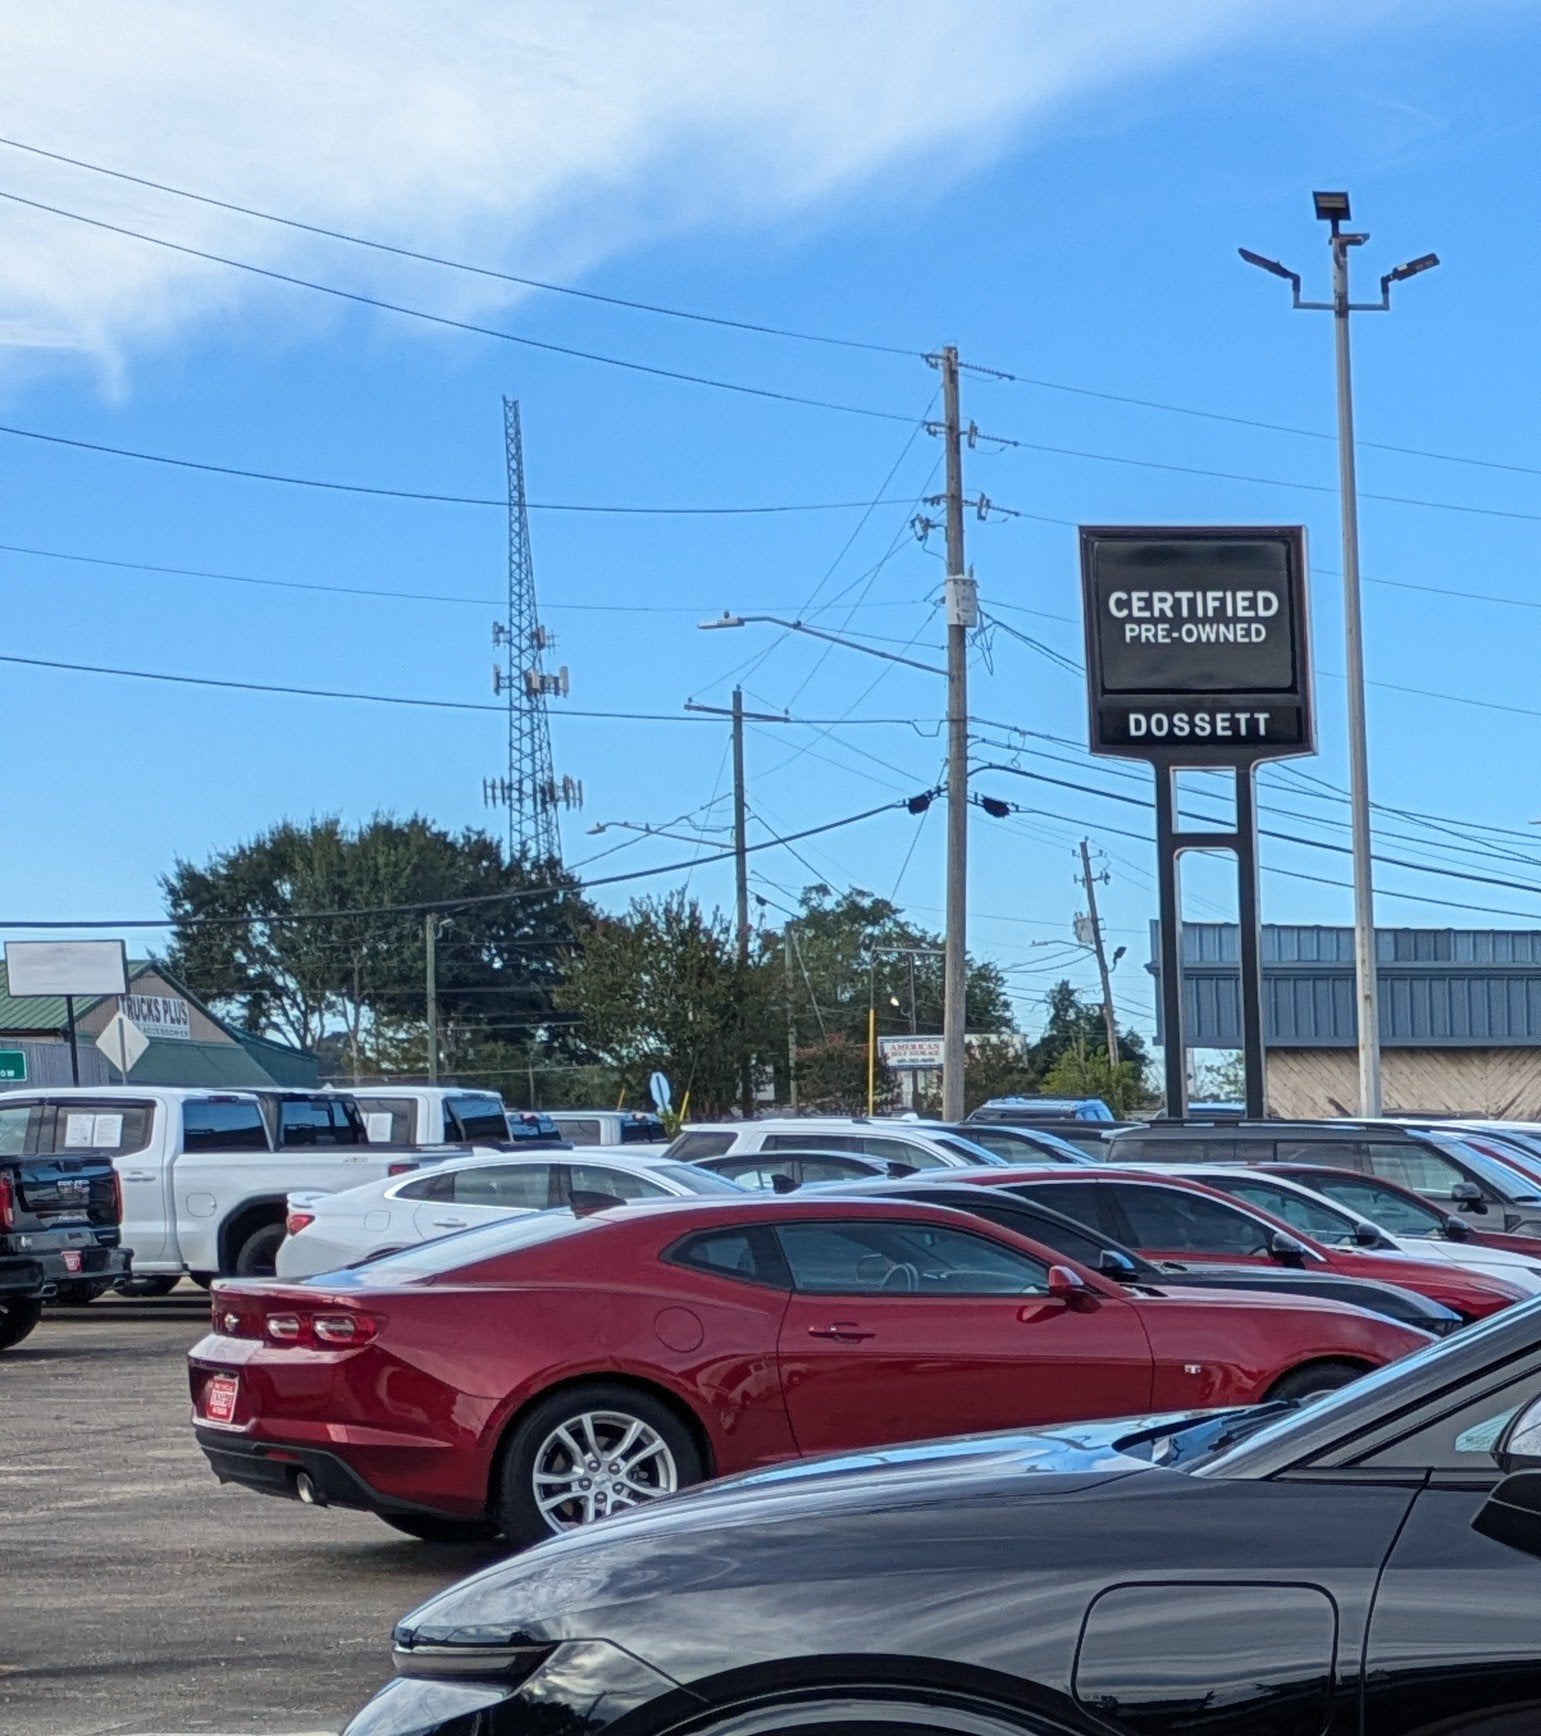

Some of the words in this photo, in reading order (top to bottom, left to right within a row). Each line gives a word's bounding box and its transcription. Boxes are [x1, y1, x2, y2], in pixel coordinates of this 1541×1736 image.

[1108, 590, 1280, 619] CERTIFIED
[1124, 622, 1267, 644] PRE-OWNED
[1128, 712, 1271, 737] DOSSETT
[162, 999, 188, 1026] PLUS
